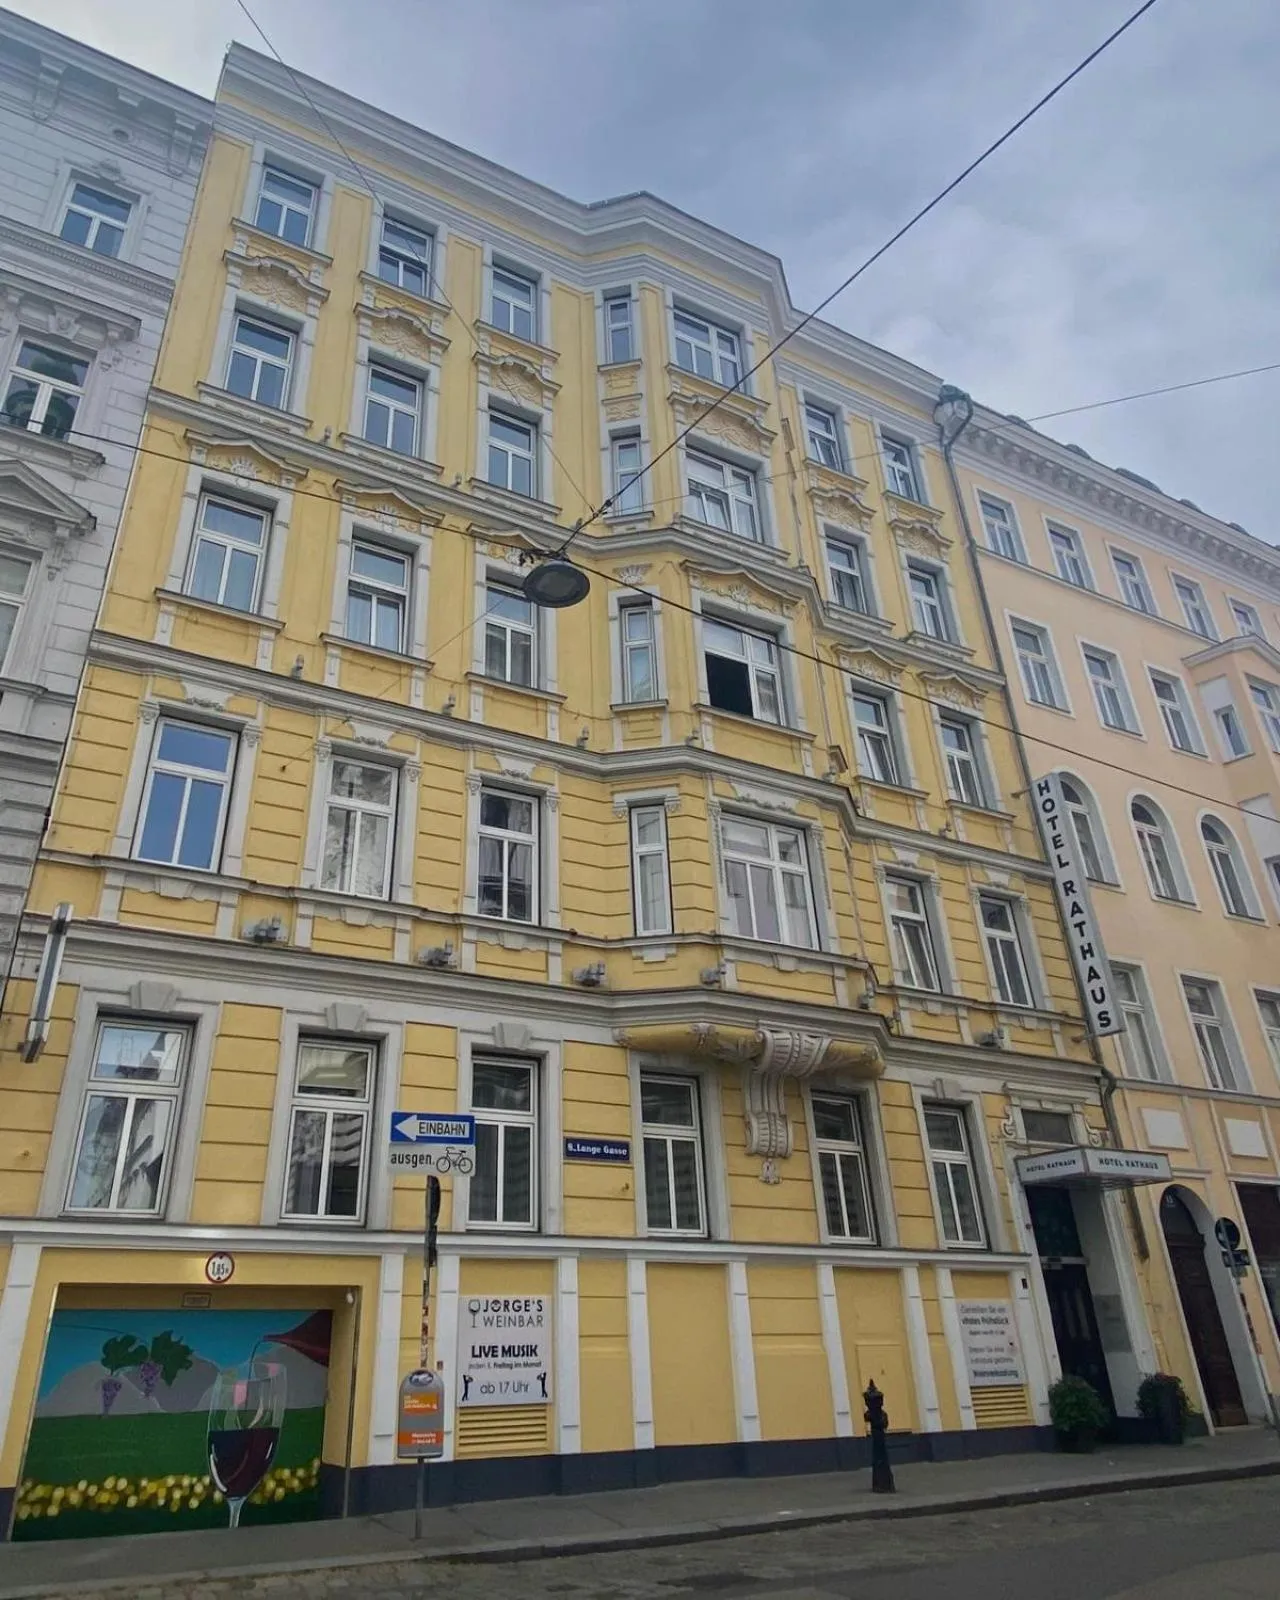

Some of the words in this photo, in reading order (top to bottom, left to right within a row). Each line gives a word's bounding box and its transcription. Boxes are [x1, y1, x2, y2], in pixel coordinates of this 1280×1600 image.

[1037, 779, 1069, 869] HOTEL
[1062, 880, 1112, 1028] RATHAUS
[418, 1121, 466, 1137] EINBAHN
[577, 1143, 601, 1155] Lange
[390, 1151, 435, 1168] ausgen.
[1026, 1165, 1046, 1173] HOTEL
[1047, 1159, 1076, 1169] RATHAUS
[1099, 1157, 1122, 1168] HOTEL
[1125, 1159, 1160, 1170] RATHAUS
[483, 1299, 543, 1313] JORGE'S
[483, 1314, 544, 1328] WEINBAR
[471, 1345, 499, 1358] LIVE
[501, 1344, 538, 1358] MUSIK
[523, 1360, 542, 1368] Monat
[479, 1382, 495, 1394] ab
[499, 1381, 510, 1393] 17
[512, 1380, 530, 1393] Uhr
